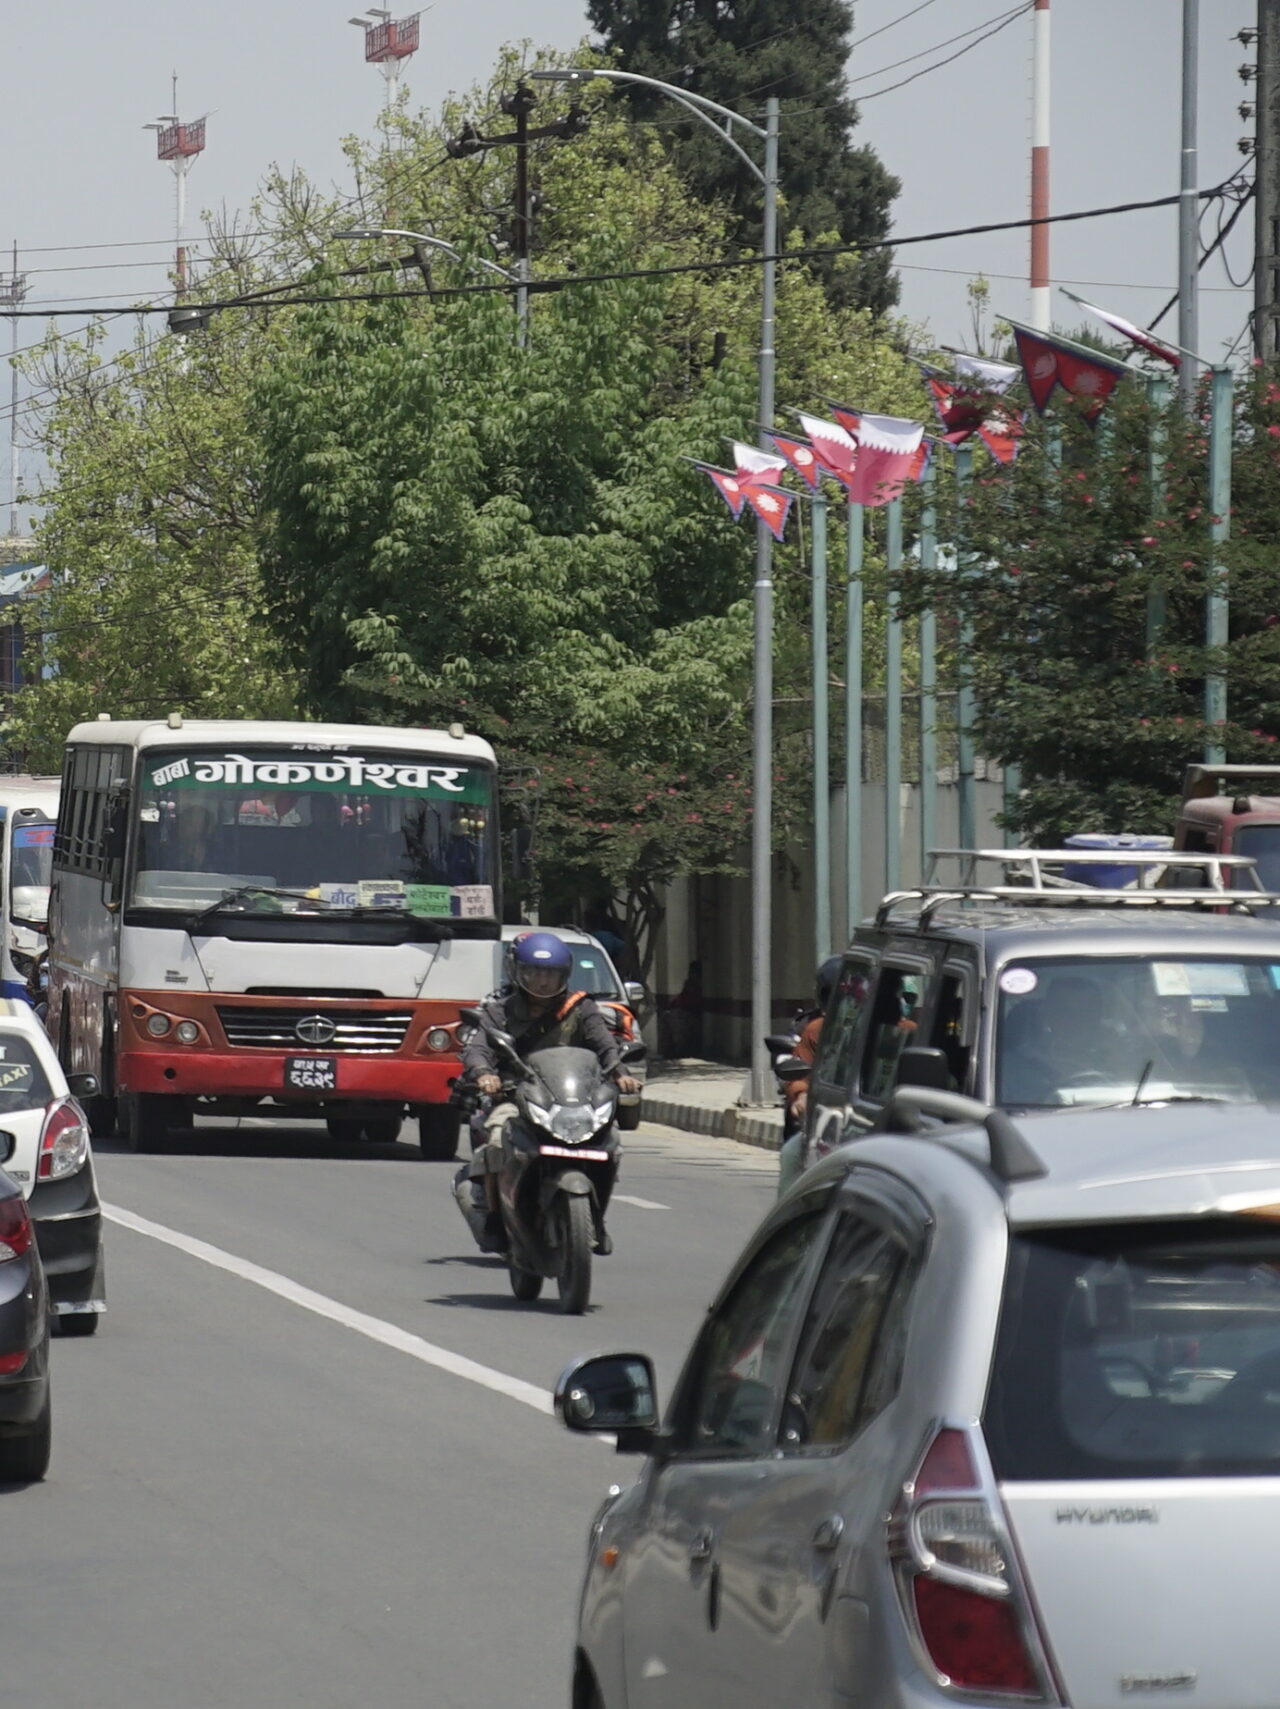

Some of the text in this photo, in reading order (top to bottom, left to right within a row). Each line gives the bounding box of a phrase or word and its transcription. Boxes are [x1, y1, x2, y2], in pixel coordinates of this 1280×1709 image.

[150, 753, 469, 792] बाबा गोकर्णेश्वर
[290, 1070, 335, 1089] ६६३९
